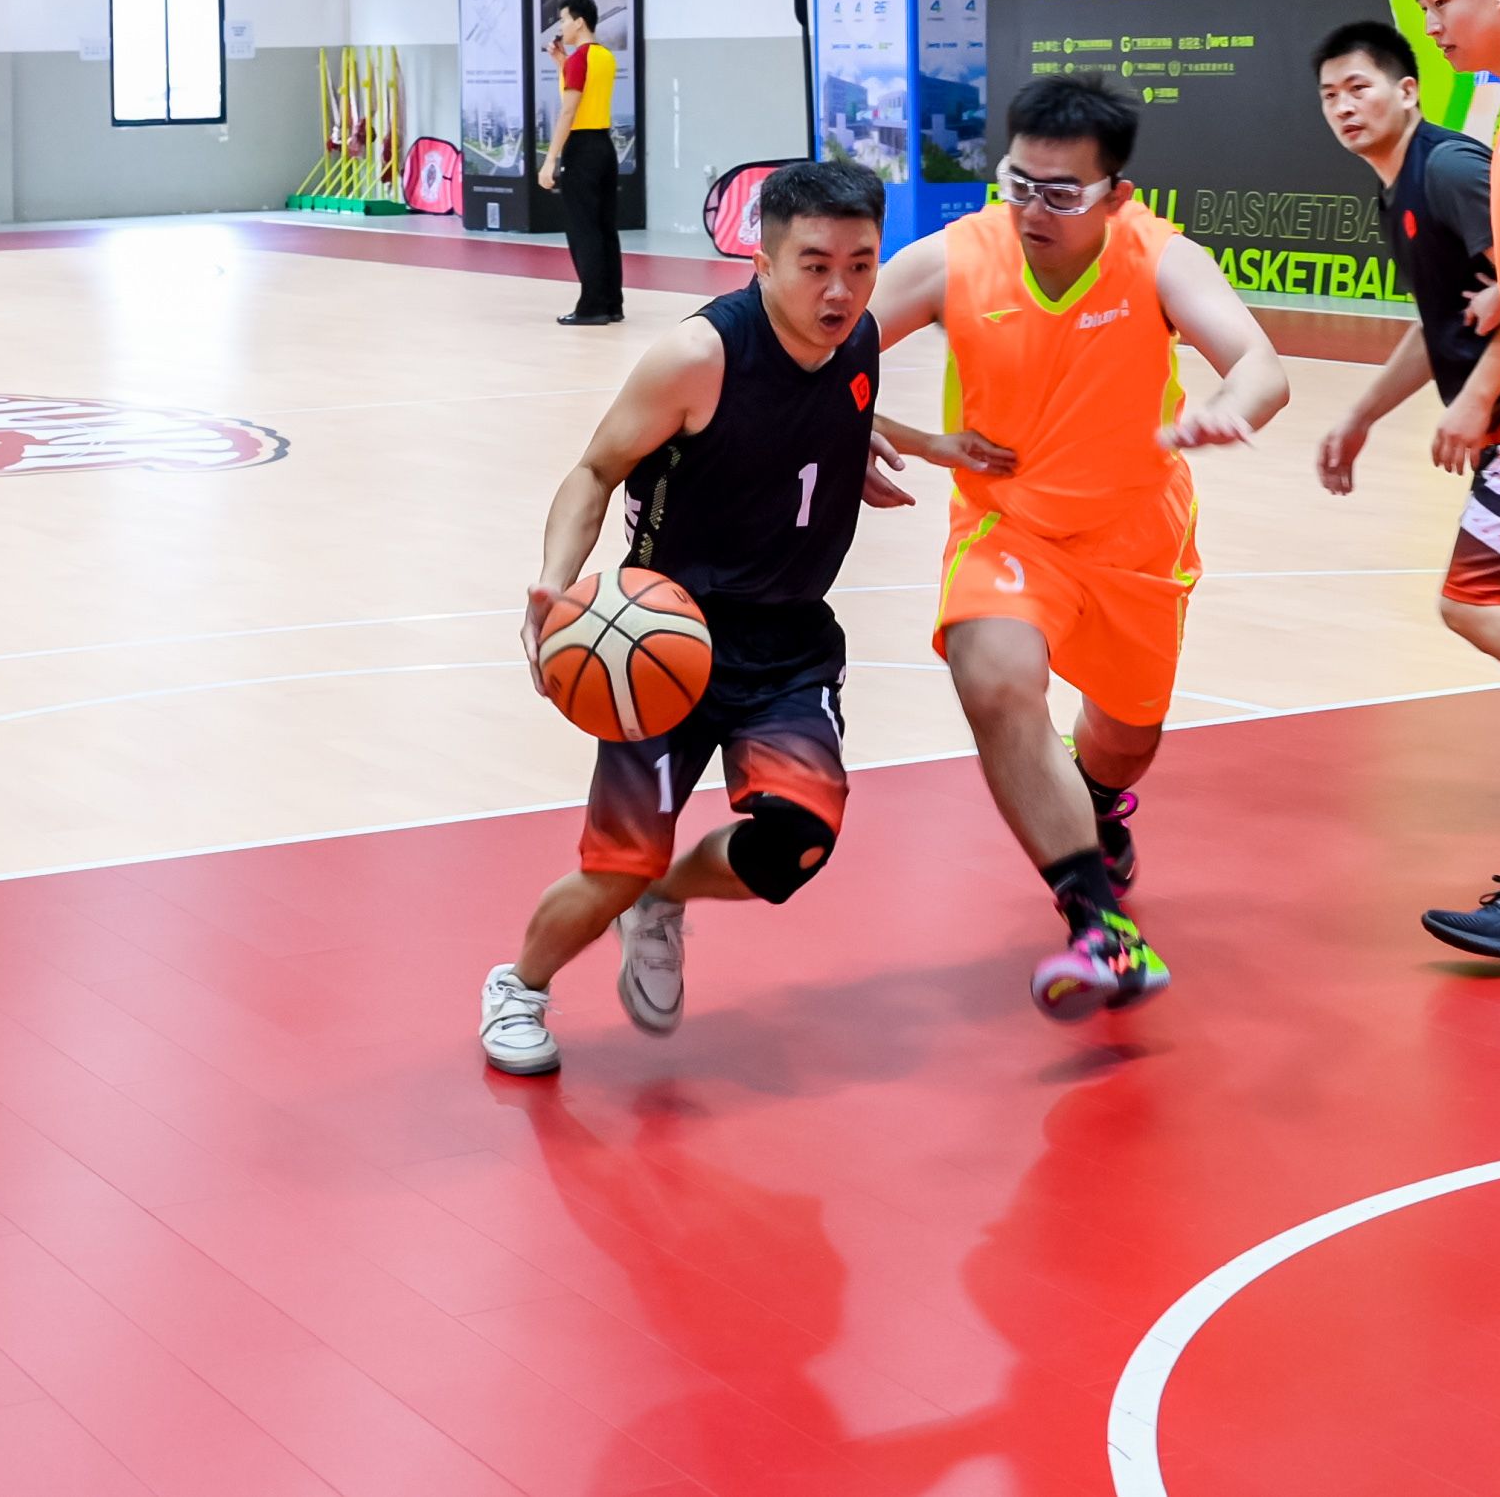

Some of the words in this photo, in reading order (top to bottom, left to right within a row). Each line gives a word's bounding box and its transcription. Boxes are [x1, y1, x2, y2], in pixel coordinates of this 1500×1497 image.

[1192, 189, 1386, 244] BASKETBA
[1203, 246, 1416, 302] ASKETBAL
[795, 463, 818, 527] 1
[654, 753, 672, 814] 1
